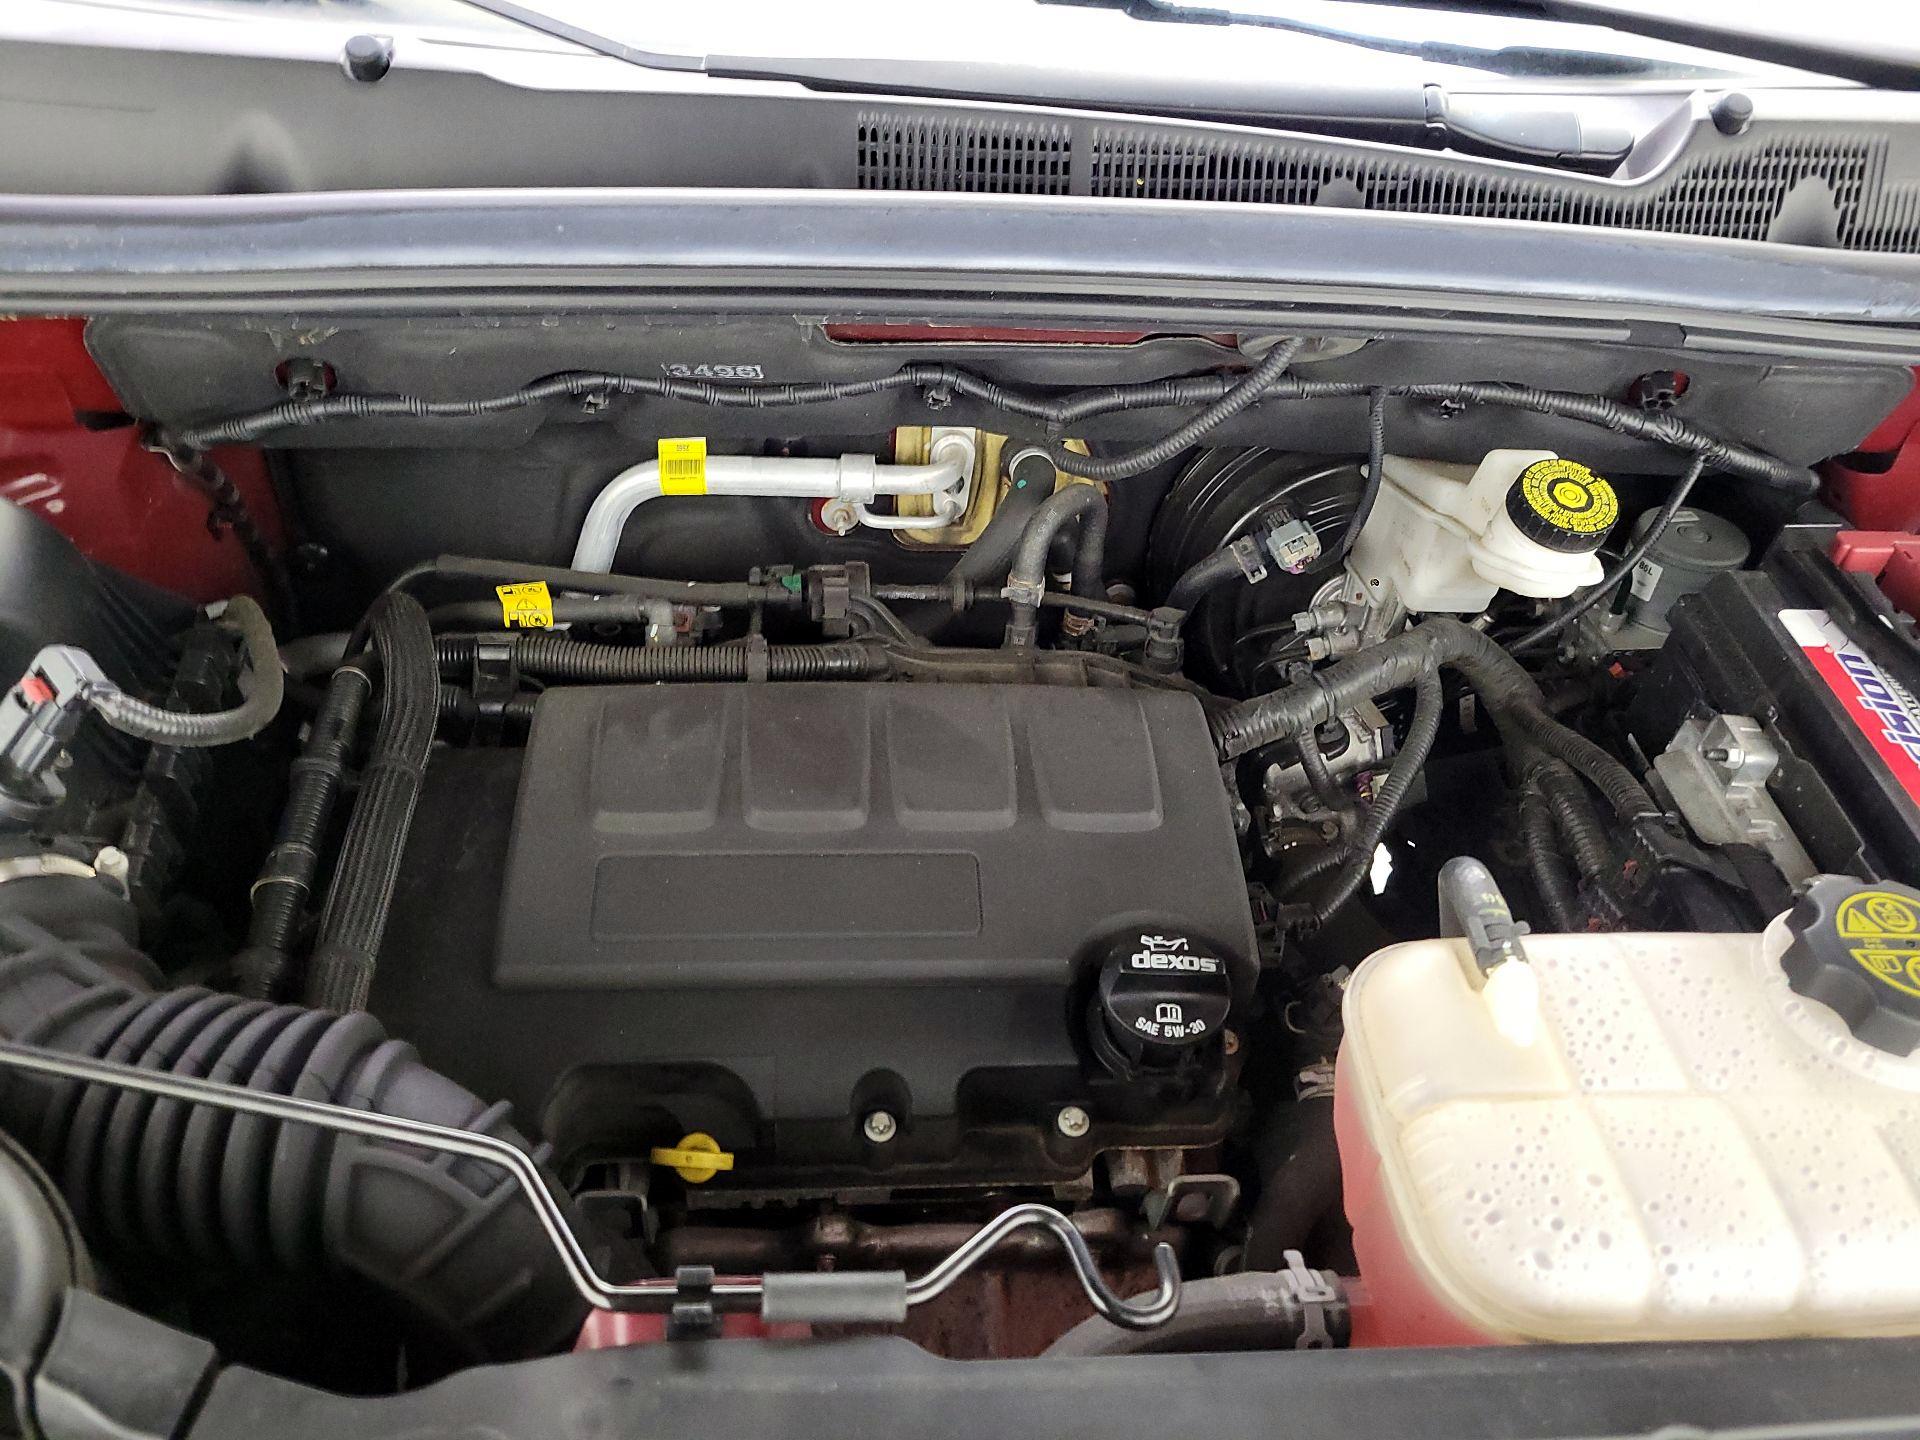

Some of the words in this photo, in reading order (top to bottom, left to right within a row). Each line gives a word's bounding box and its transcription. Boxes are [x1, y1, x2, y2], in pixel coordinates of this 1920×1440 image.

[1131, 949, 1218, 973] dexos
[1135, 1016, 1160, 1037] SAE
[1164, 1019, 1206, 1038] 5W-30
